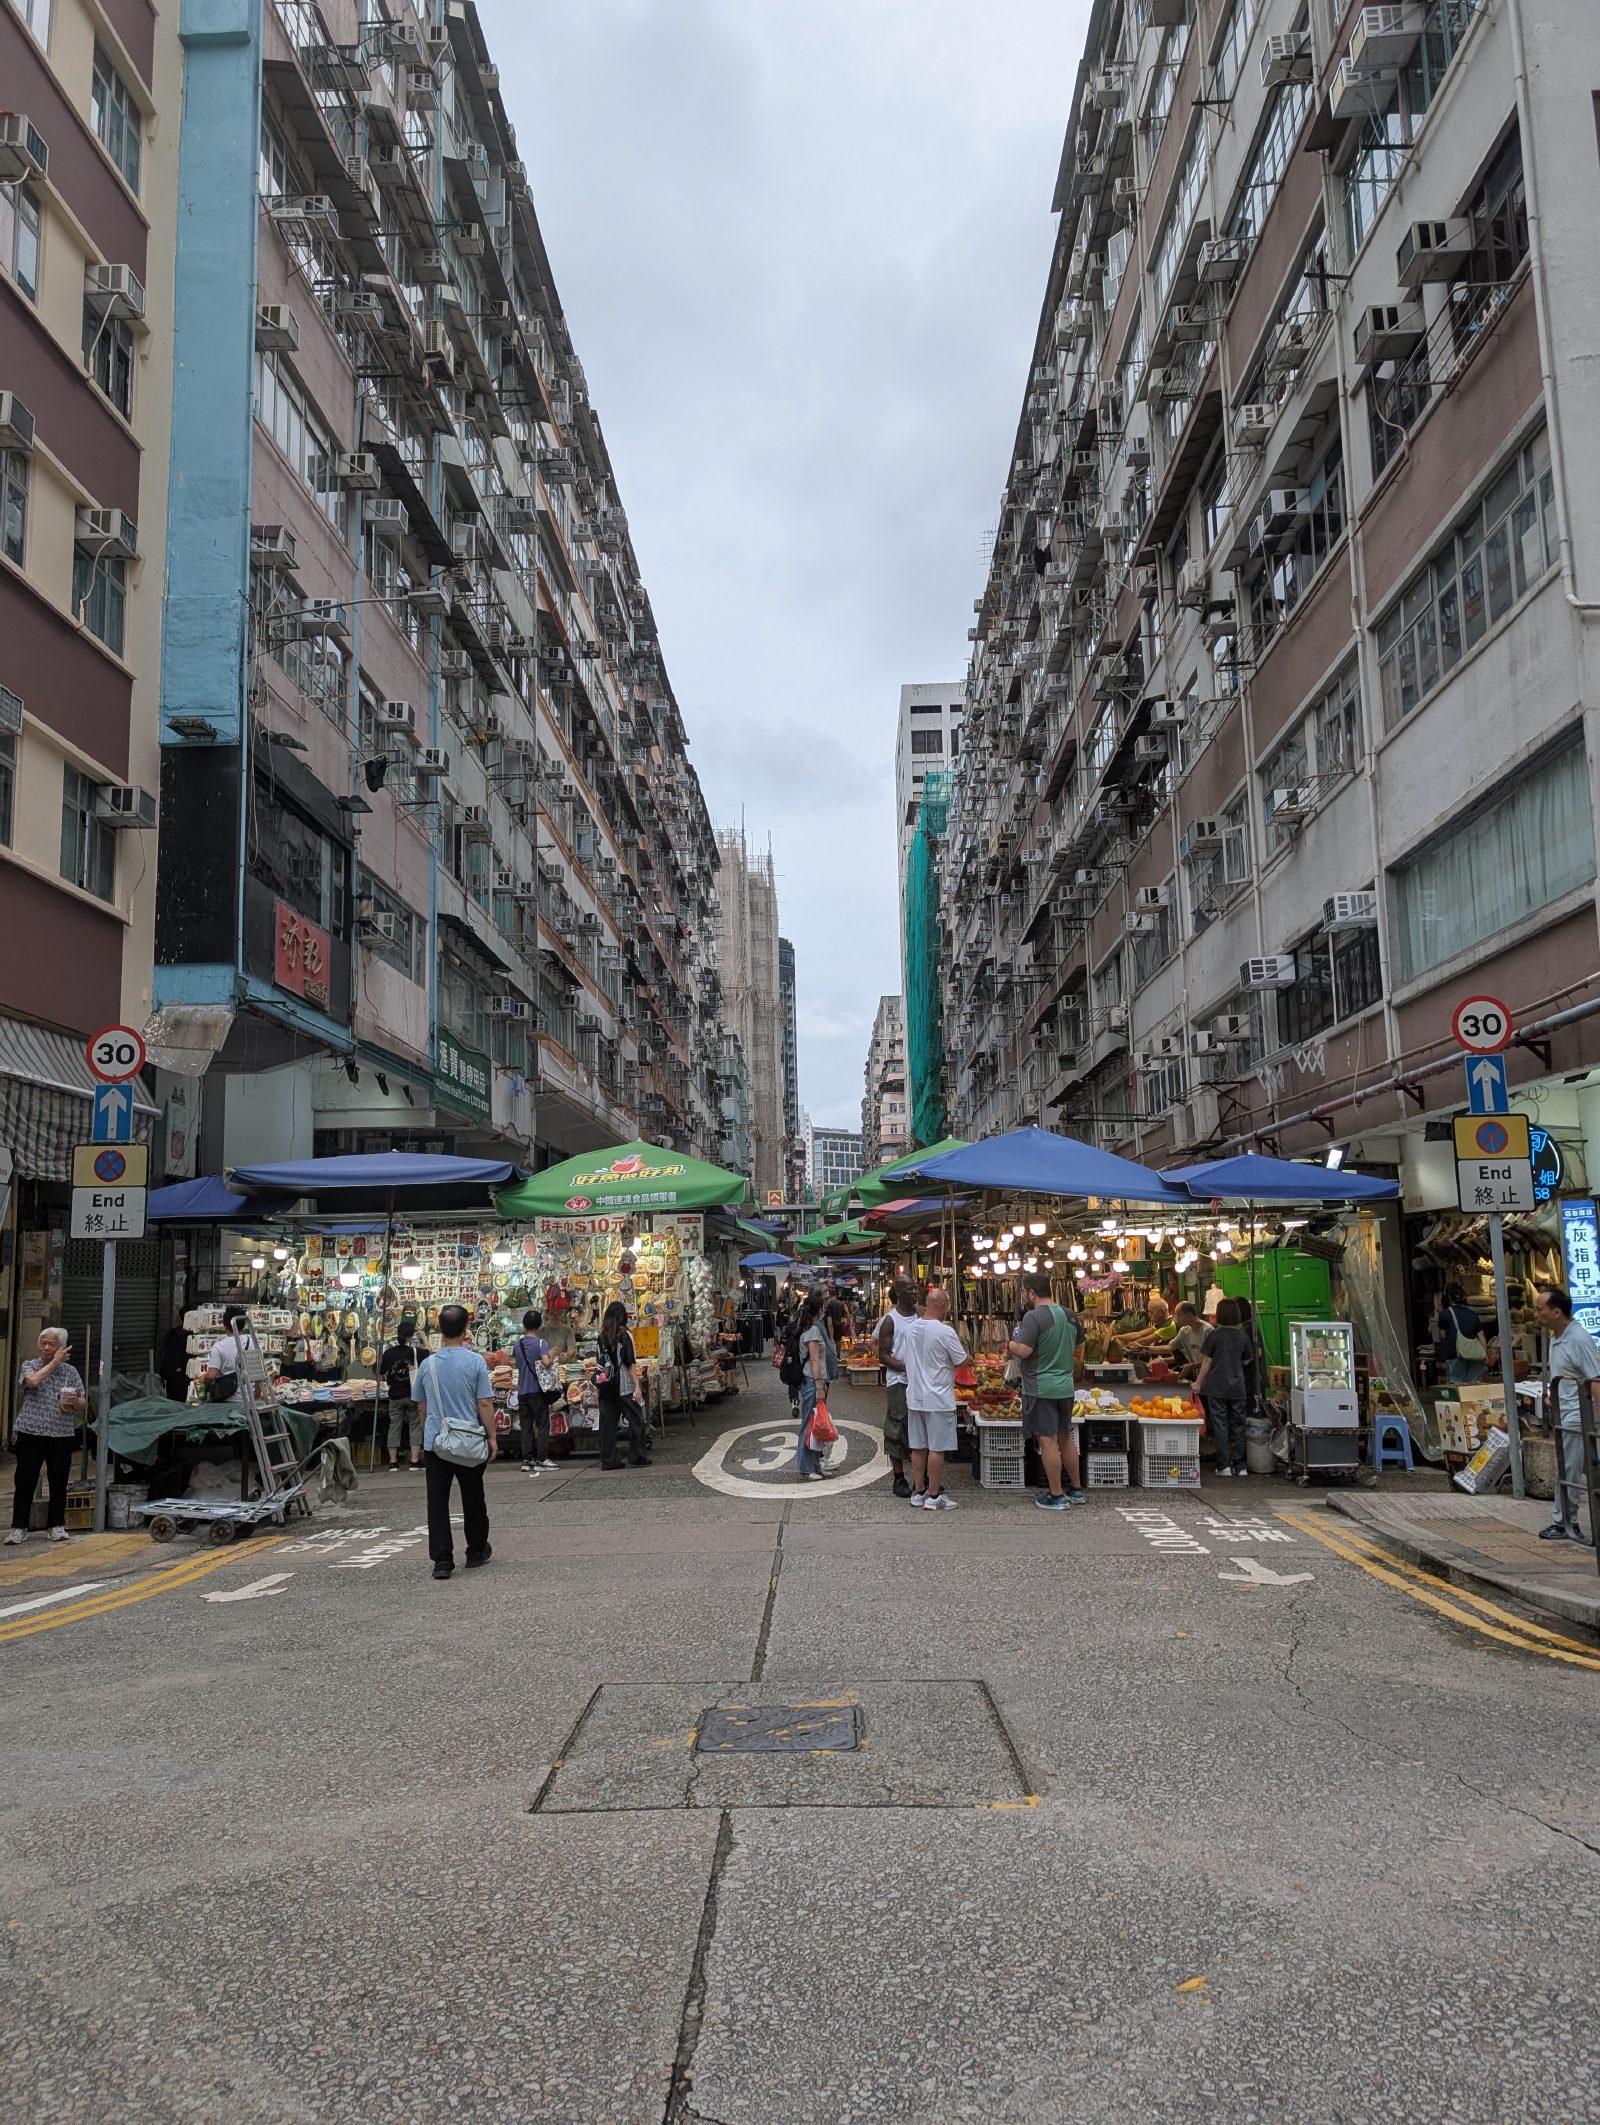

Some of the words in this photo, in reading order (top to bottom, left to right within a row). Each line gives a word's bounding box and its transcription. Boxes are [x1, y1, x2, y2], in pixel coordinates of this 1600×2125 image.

[1462, 1013, 1502, 1038] 30
[96, 1042, 136, 1065] 30
[1478, 1165, 1512, 1180] End
[92, 1194, 125, 1208] End
[1474, 1185, 1521, 1205] 終止
[84, 1213, 130, 1233] 終止
[1572, 1227, 1592, 1284] 灰指甲
[1114, 1507, 1178, 1527] LEFT
[272, 1525, 393, 1554] 望右
[1136, 1525, 1212, 1554] LOOK
[1195, 1516, 1298, 1543] 望左
[327, 1538, 422, 1569] RIGHT
